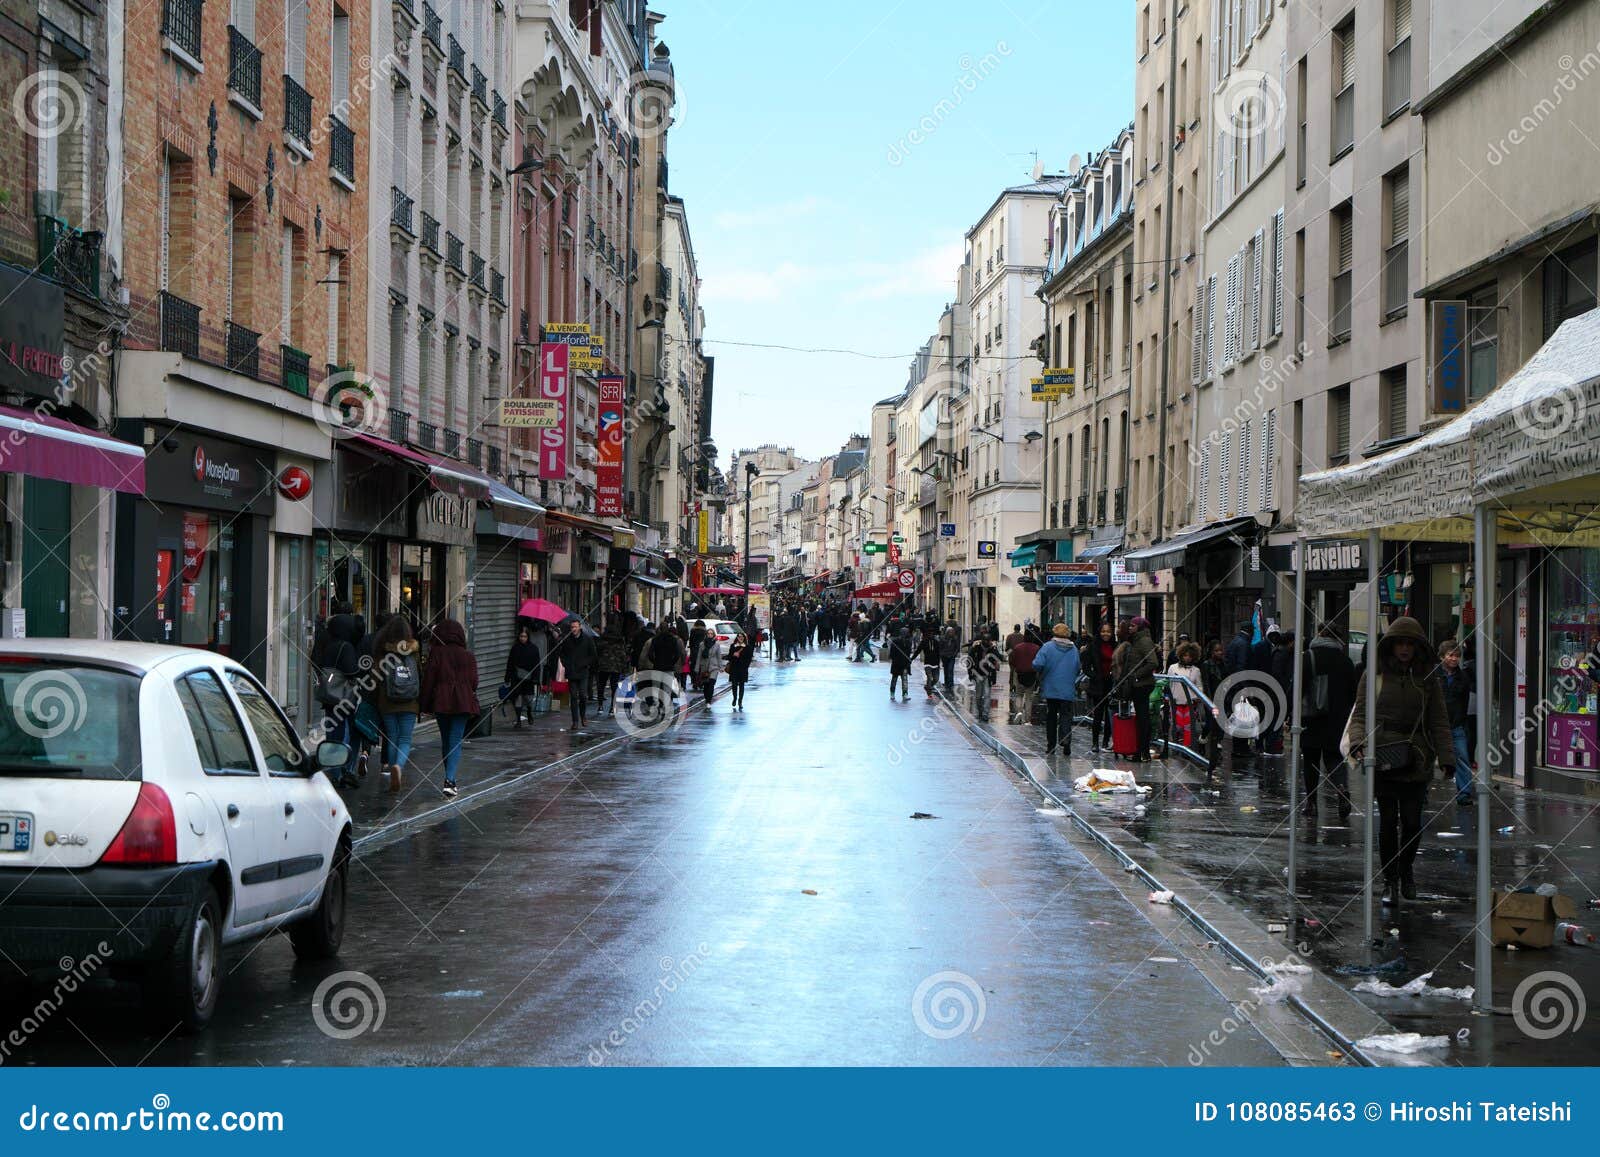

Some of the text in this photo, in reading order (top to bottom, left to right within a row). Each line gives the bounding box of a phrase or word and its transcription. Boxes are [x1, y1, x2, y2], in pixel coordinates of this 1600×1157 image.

[557, 325, 587, 333] VENDRE
[558, 334, 590, 345] laforêt
[602, 386, 619, 399] SFR
[503, 401, 554, 409] BOULANGER
[503, 417, 554, 426] GLACIER
[206, 459, 240, 484] MoneyGram
[1291, 542, 1361, 571] dlaveine
[15, 834, 29, 847] 95
